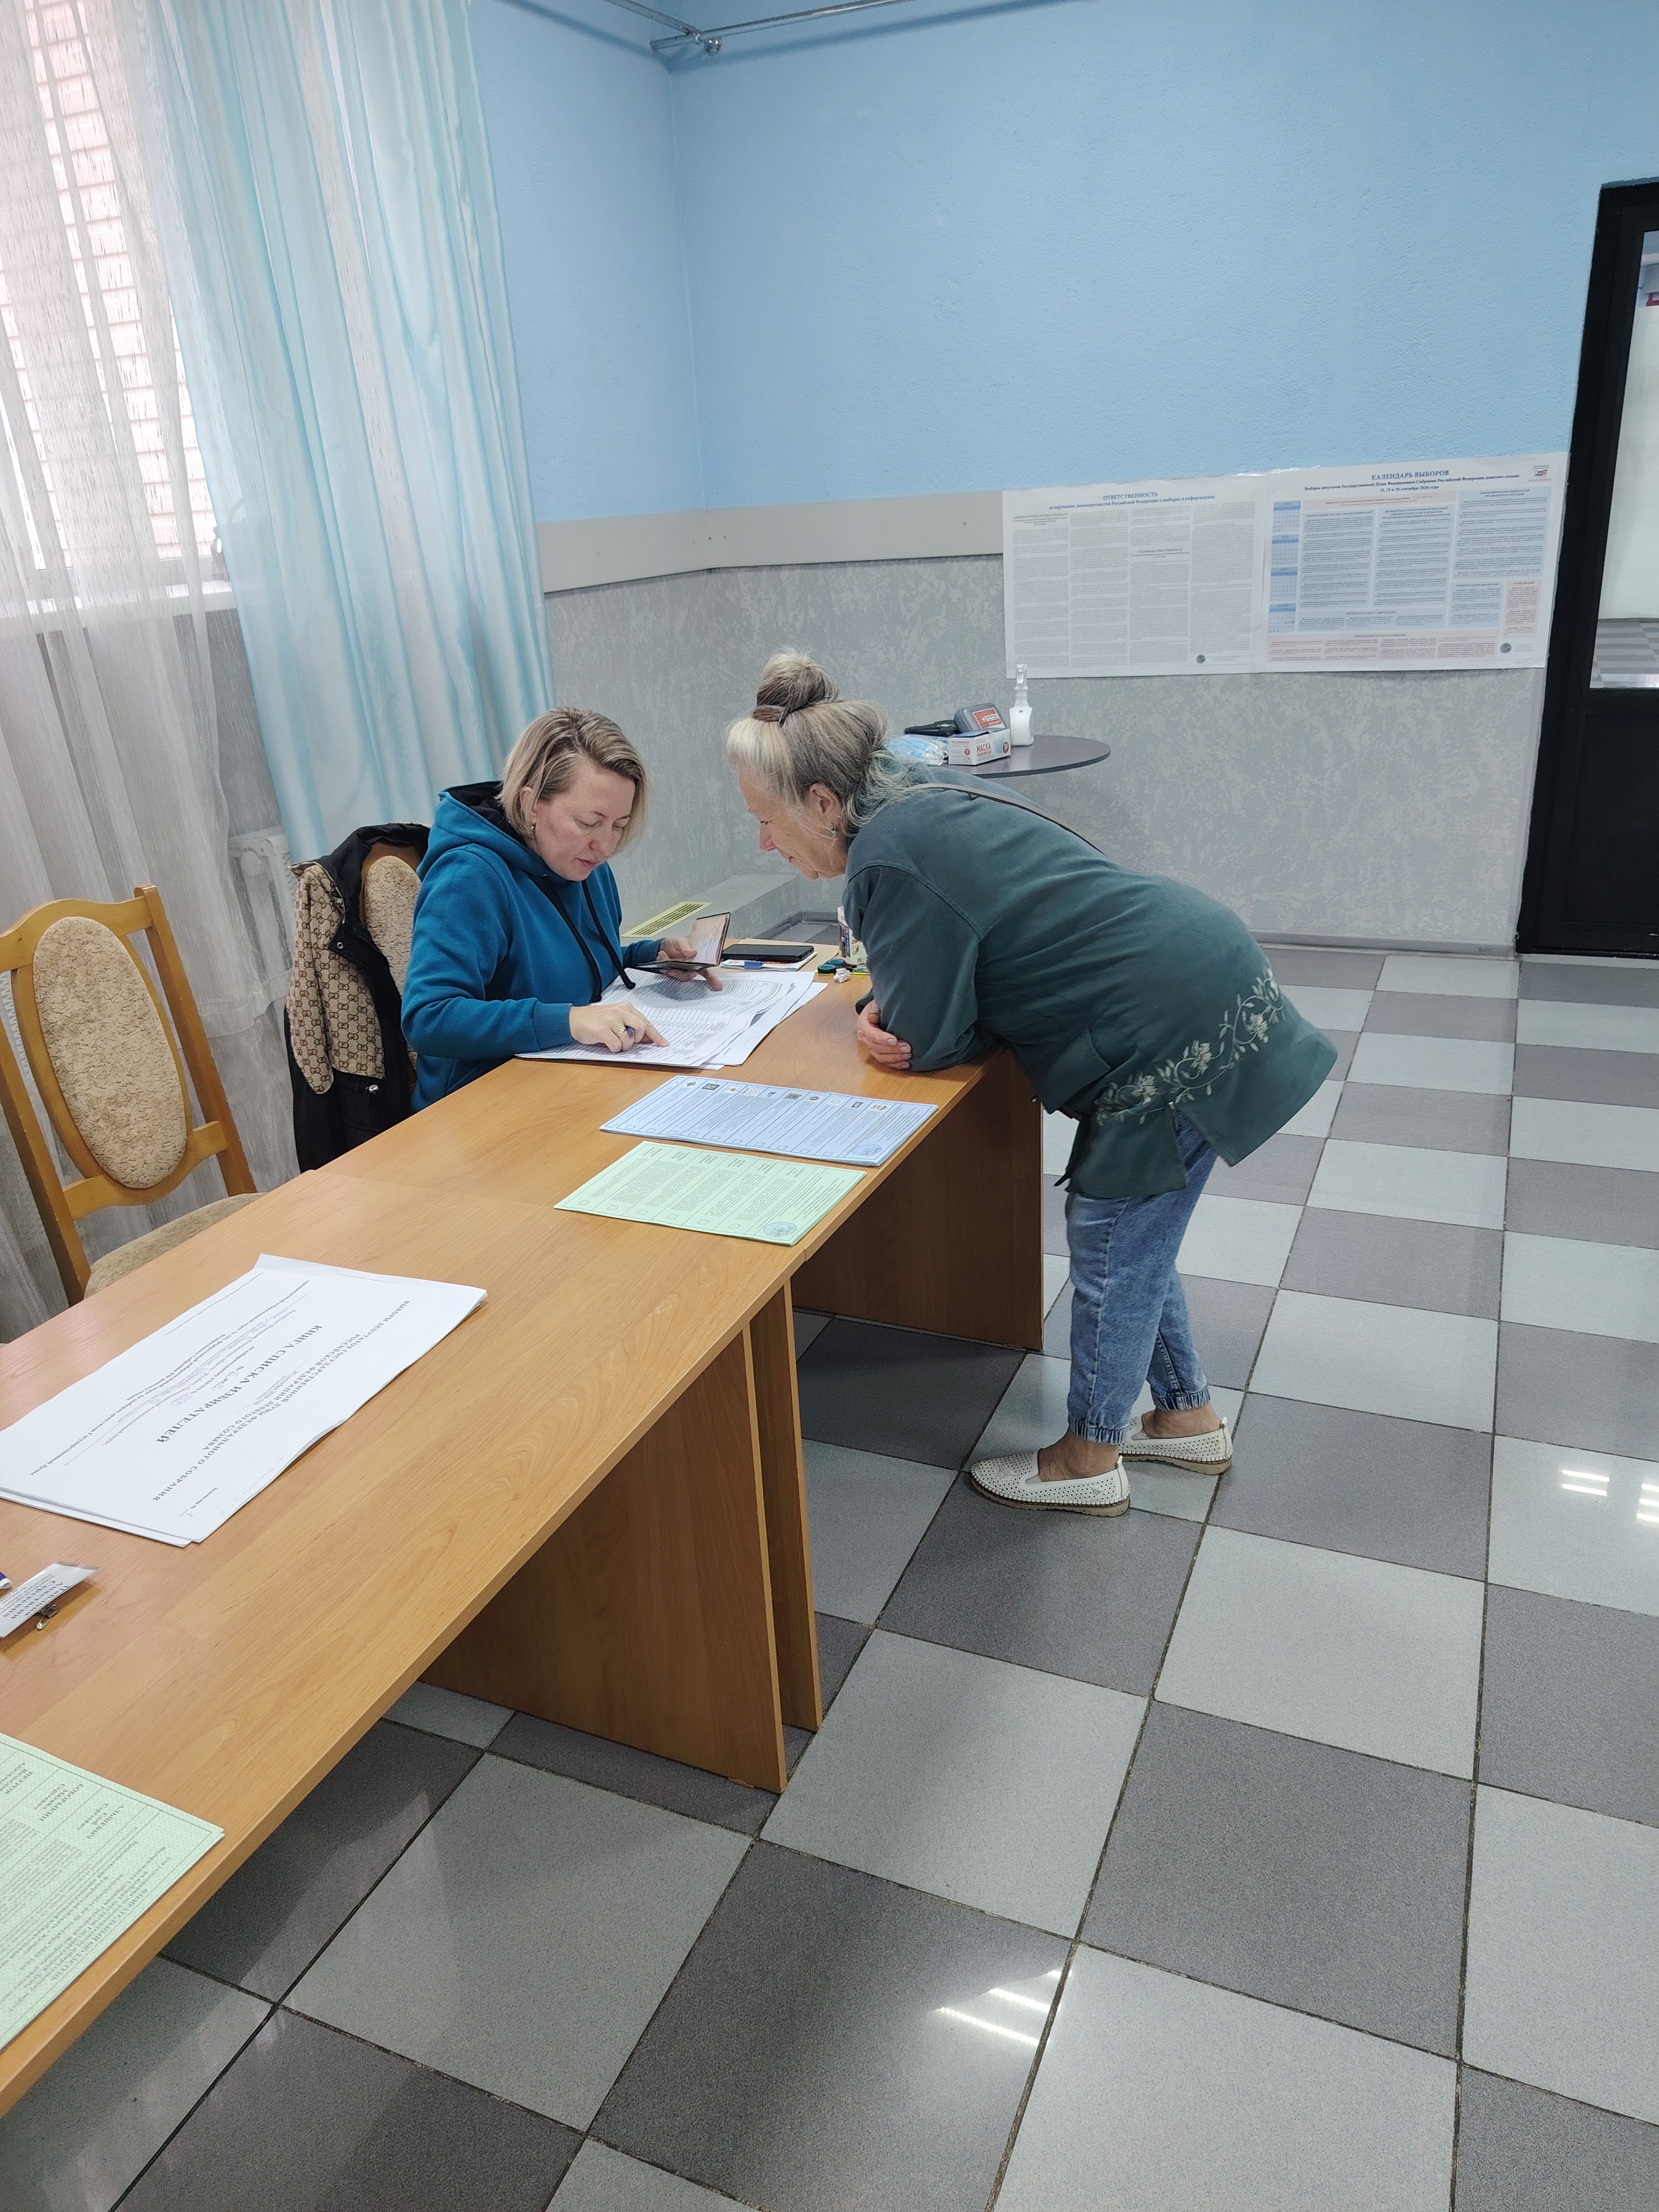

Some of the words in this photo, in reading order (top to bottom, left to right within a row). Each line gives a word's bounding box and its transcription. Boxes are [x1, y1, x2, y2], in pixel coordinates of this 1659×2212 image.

[1103, 492, 1157, 500] ОТВЕТСТВЕННОСТЬ
[977, 742, 991, 753] МАСКА
[382, 1300, 410, 1322] ВЫБОРЫ
[283, 1324, 324, 1349] КНИГА
[314, 1333, 361, 1366] РОССИЙСКОЙ
[345, 1322, 385, 1349] ДЕПУТАТОВ
[237, 1349, 288, 1385] СПИСКА
[280, 1349, 347, 1402] ГОСУДАРСТВЕННОЙ
[272, 1366, 317, 1400] ФЕДЕРАЦИИ
[154, 1385, 243, 1443] ИЗБИРАТЕЛЕЙ
[233, 1400, 275, 1424] ДЕВЯТОГО
[256, 1402, 283, 1416] ДУМЫ
[45, 1432, 93, 1464] Государственной
[195, 1415, 258, 1465] ФЕДЕРАЛЬНОГО
[200, 1425, 237, 1451] СОЗЫВА
[152, 1465, 199, 1501] СОБРАНИЯ
[2, 1580, 57, 1617] Сергеевна
[9, 1581, 66, 1619] Анастасия
[4, 1771, 33, 1794] ПЕТРОВ
[33, 1783, 66, 1810] Сергеевич
[38, 1783, 84, 1822] БОБОРЫКИН
[42, 1788, 69, 1809] Михаил
[76, 1802, 109, 1830] Сергеевич
